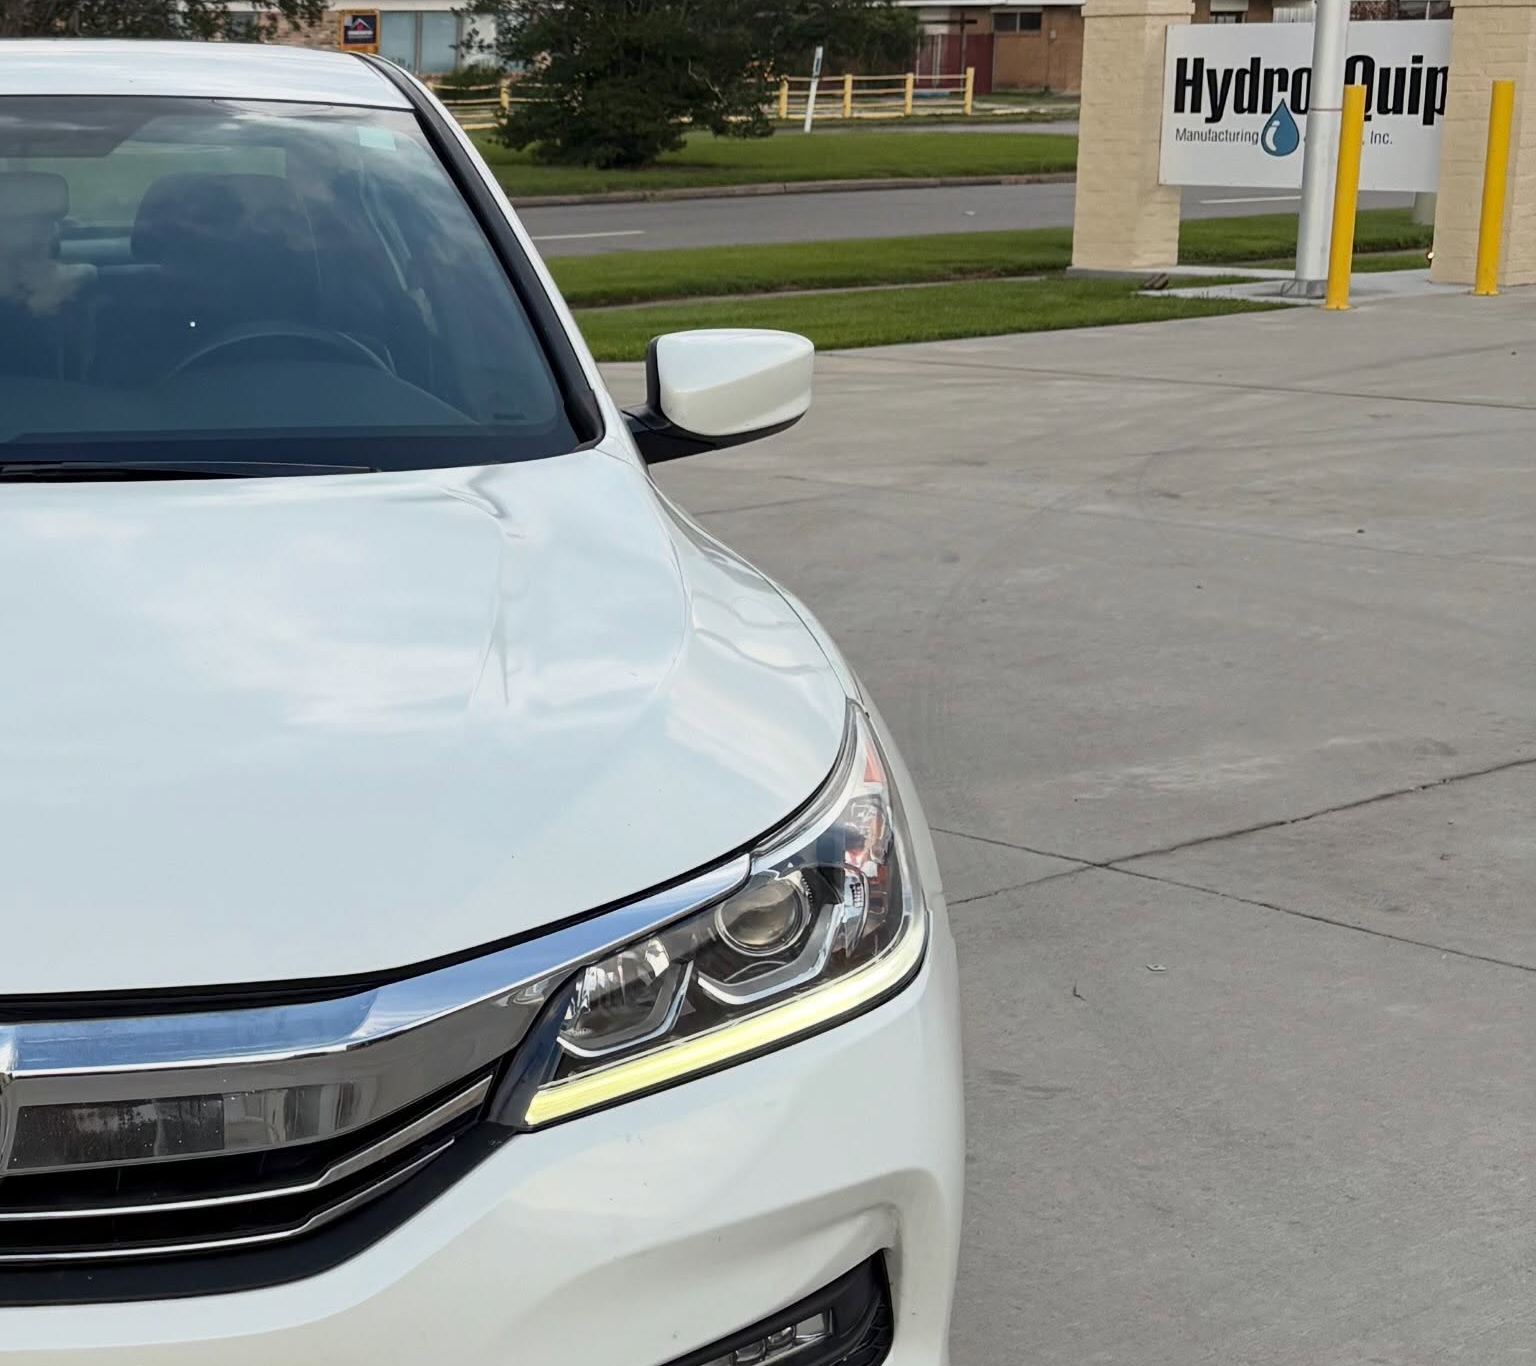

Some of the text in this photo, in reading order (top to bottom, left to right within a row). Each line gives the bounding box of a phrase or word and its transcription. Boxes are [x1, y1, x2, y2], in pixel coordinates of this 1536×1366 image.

[1174, 55, 1448, 125] Hydro Quip
[1175, 128, 1259, 145] Manufacturing
[1370, 131, 1393, 145] Inc.
